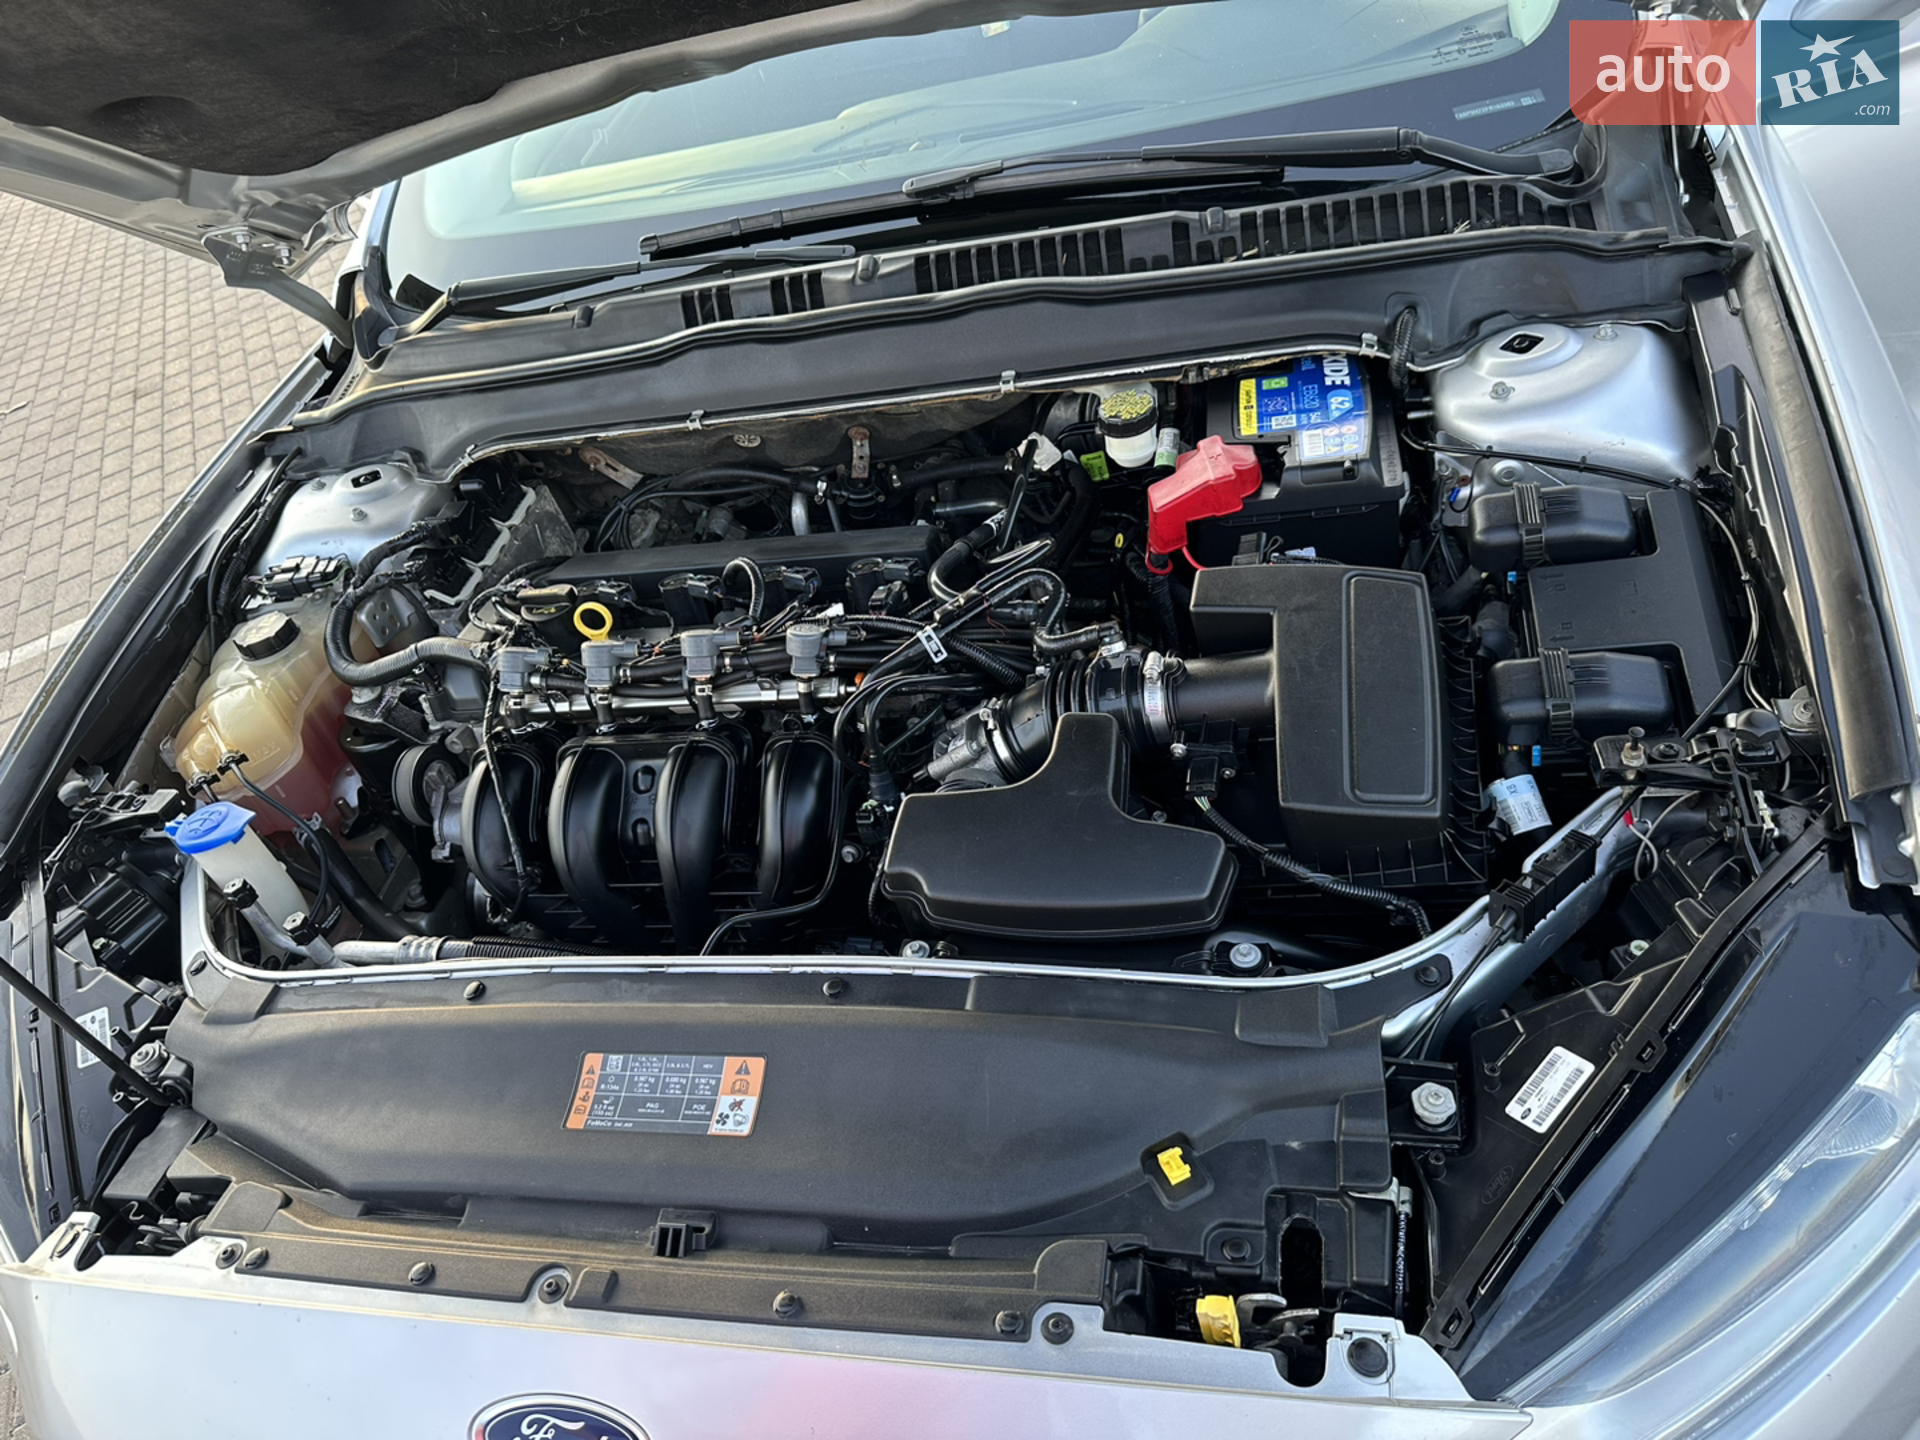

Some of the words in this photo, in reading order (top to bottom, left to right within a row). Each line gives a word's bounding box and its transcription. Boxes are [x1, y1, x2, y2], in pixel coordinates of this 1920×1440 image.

[1322, 354, 1351, 387] XIDE
[1303, 384, 1320, 409] EB620
[1330, 396, 1351, 411] 62
